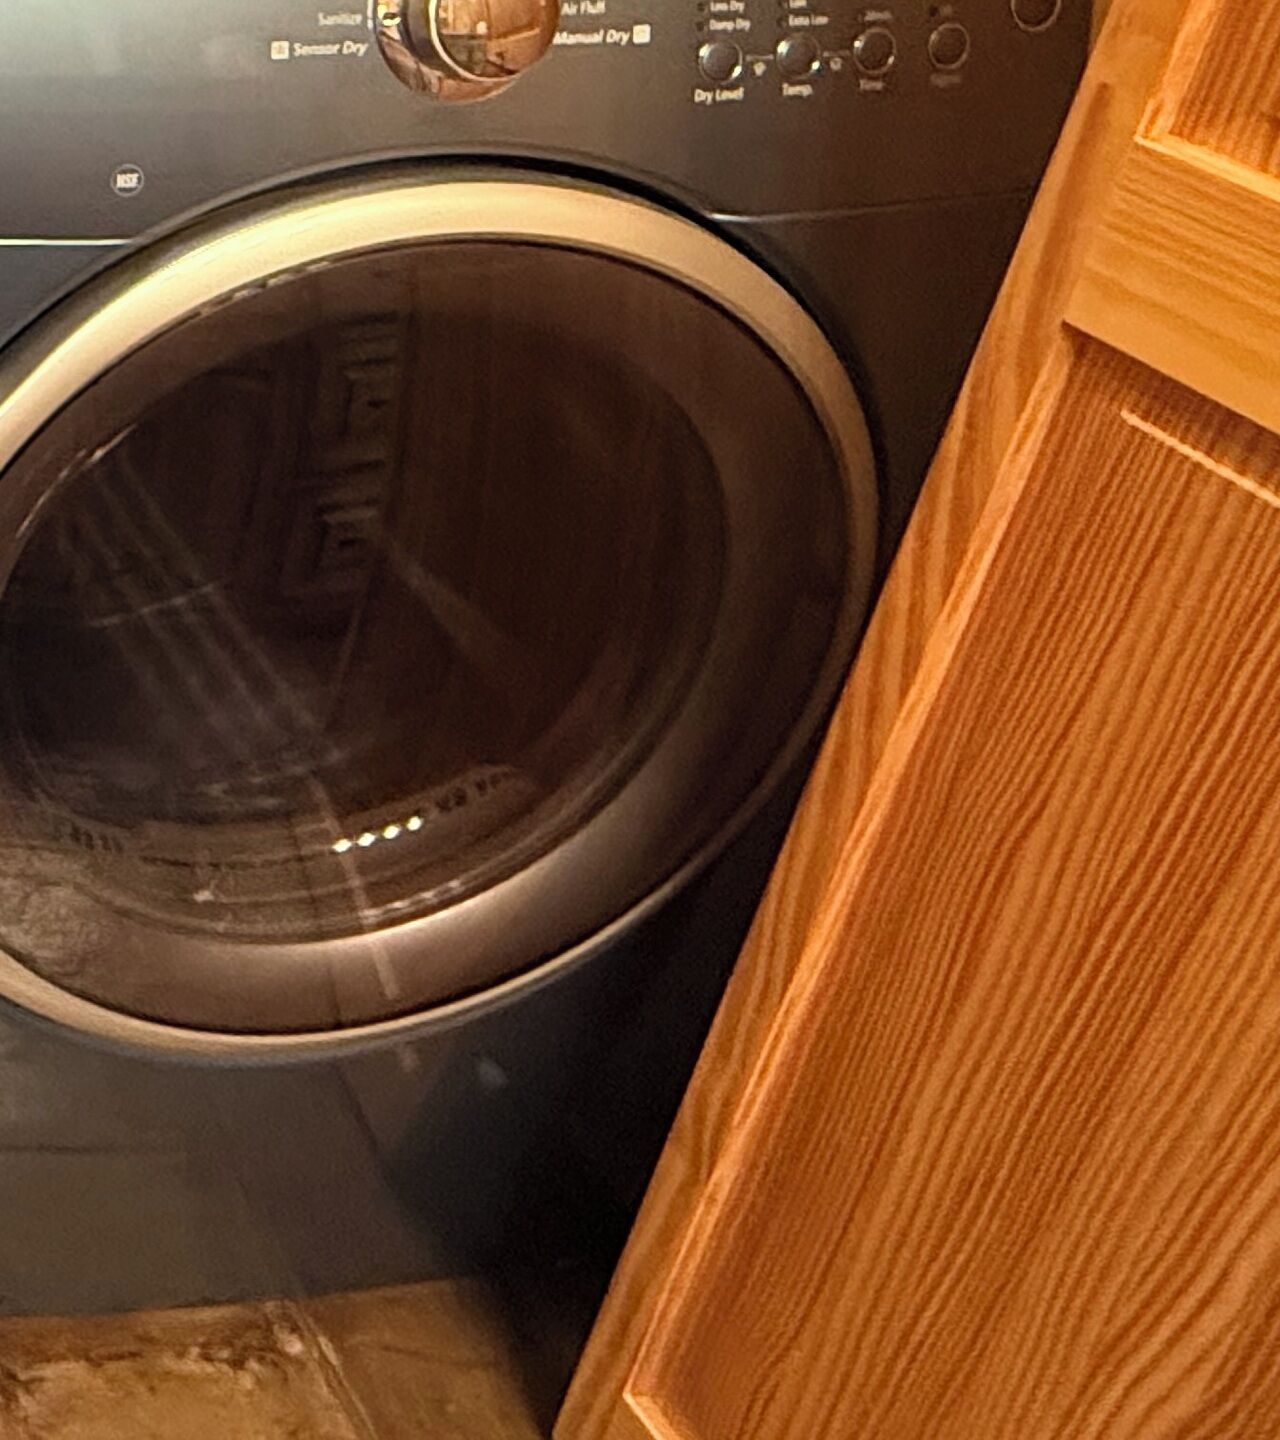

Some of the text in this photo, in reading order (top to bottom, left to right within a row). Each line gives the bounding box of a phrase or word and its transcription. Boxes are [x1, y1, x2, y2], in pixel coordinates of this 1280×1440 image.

[560, 0, 606, 17] Air Fluff
[552, 29, 631, 46] Manual Dry
[292, 39, 369, 58] Sensor Dry
[693, 86, 745, 106] Dry Level
